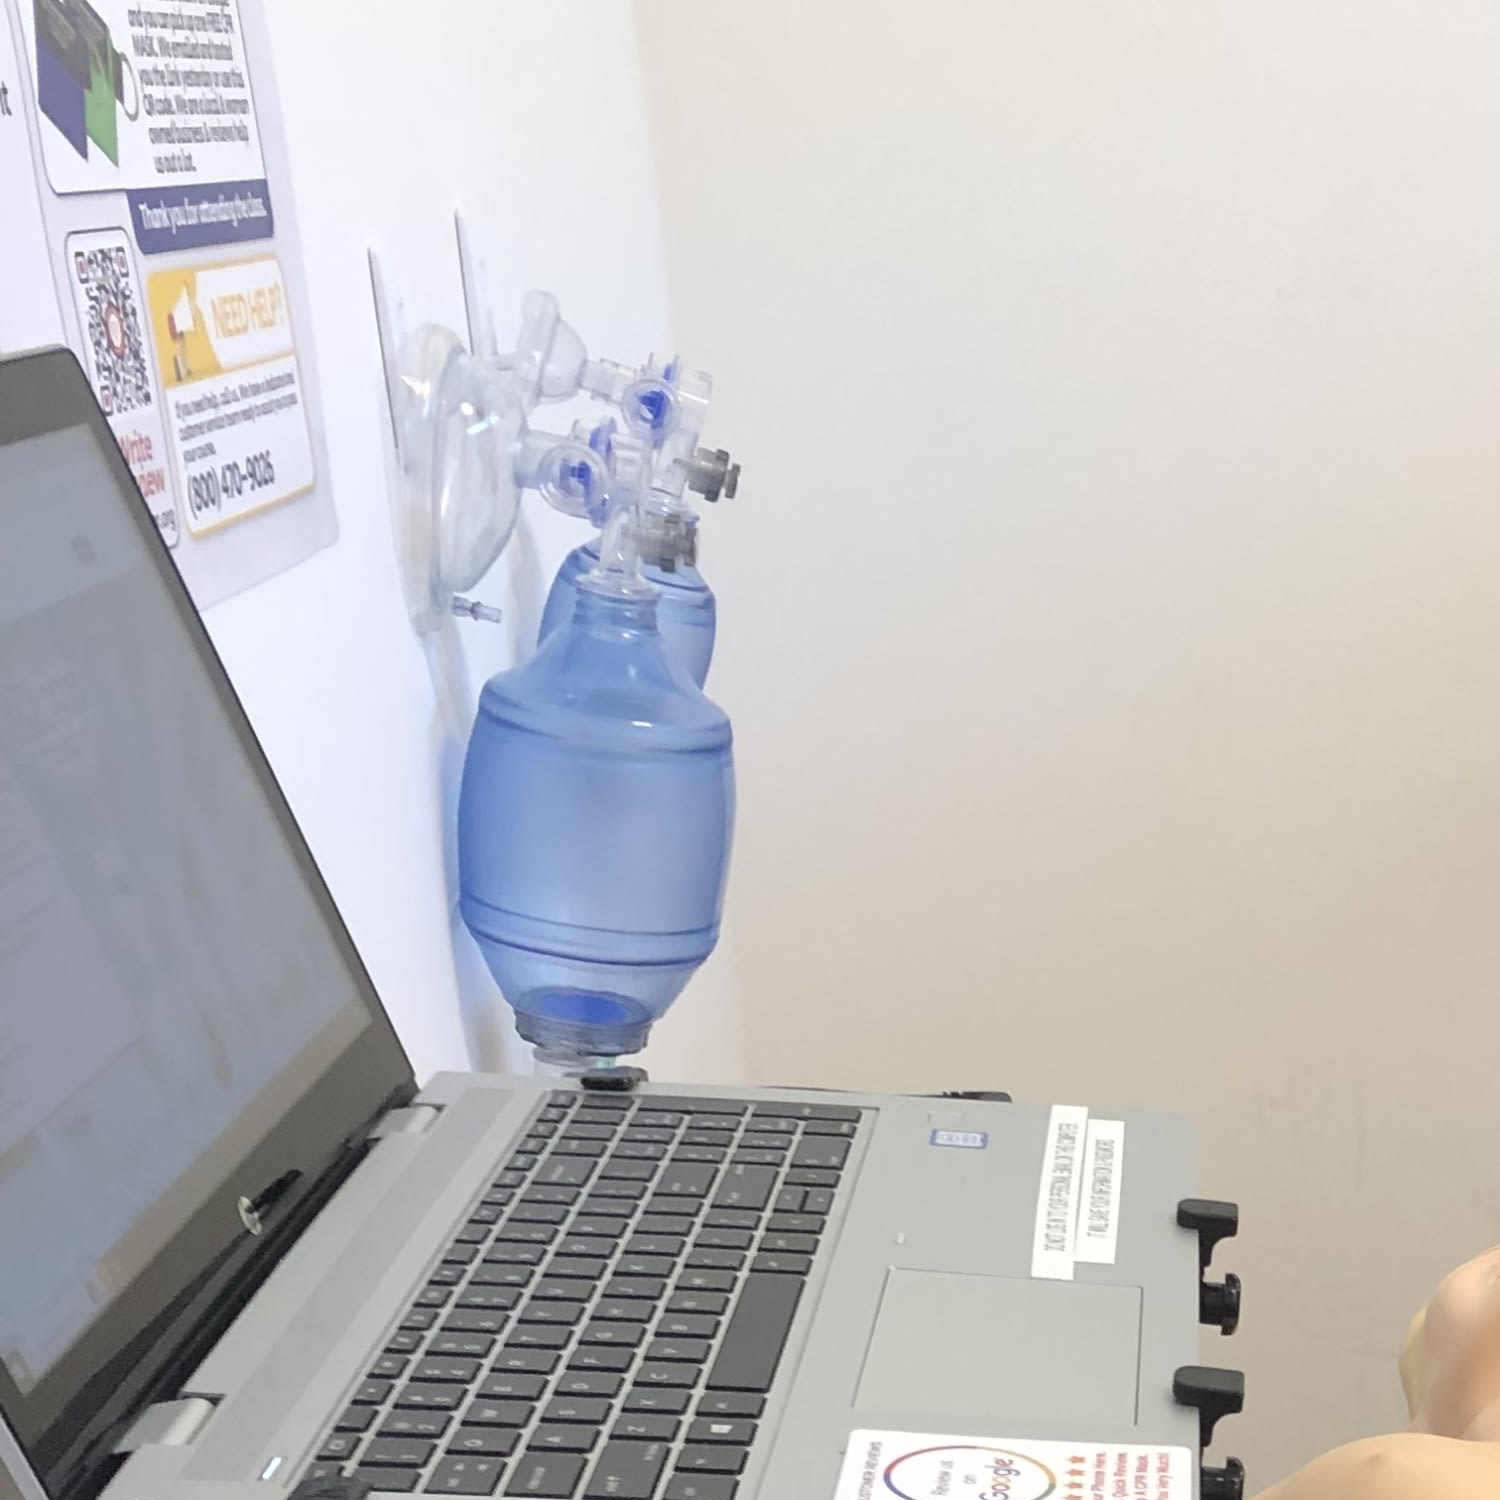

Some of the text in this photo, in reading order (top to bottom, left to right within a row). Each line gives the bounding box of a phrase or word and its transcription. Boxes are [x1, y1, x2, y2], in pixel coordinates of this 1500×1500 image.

[211, 292, 249, 339] NEED
[188, 467, 222, 520] (800)
[864, 1441, 882, 1469] REVIEWS
[930, 1460, 954, 1496] Review us
[963, 1475, 976, 1484] on
[1090, 1471, 1104, 1491] Phone
[1134, 1475, 1147, 1489] CPR
